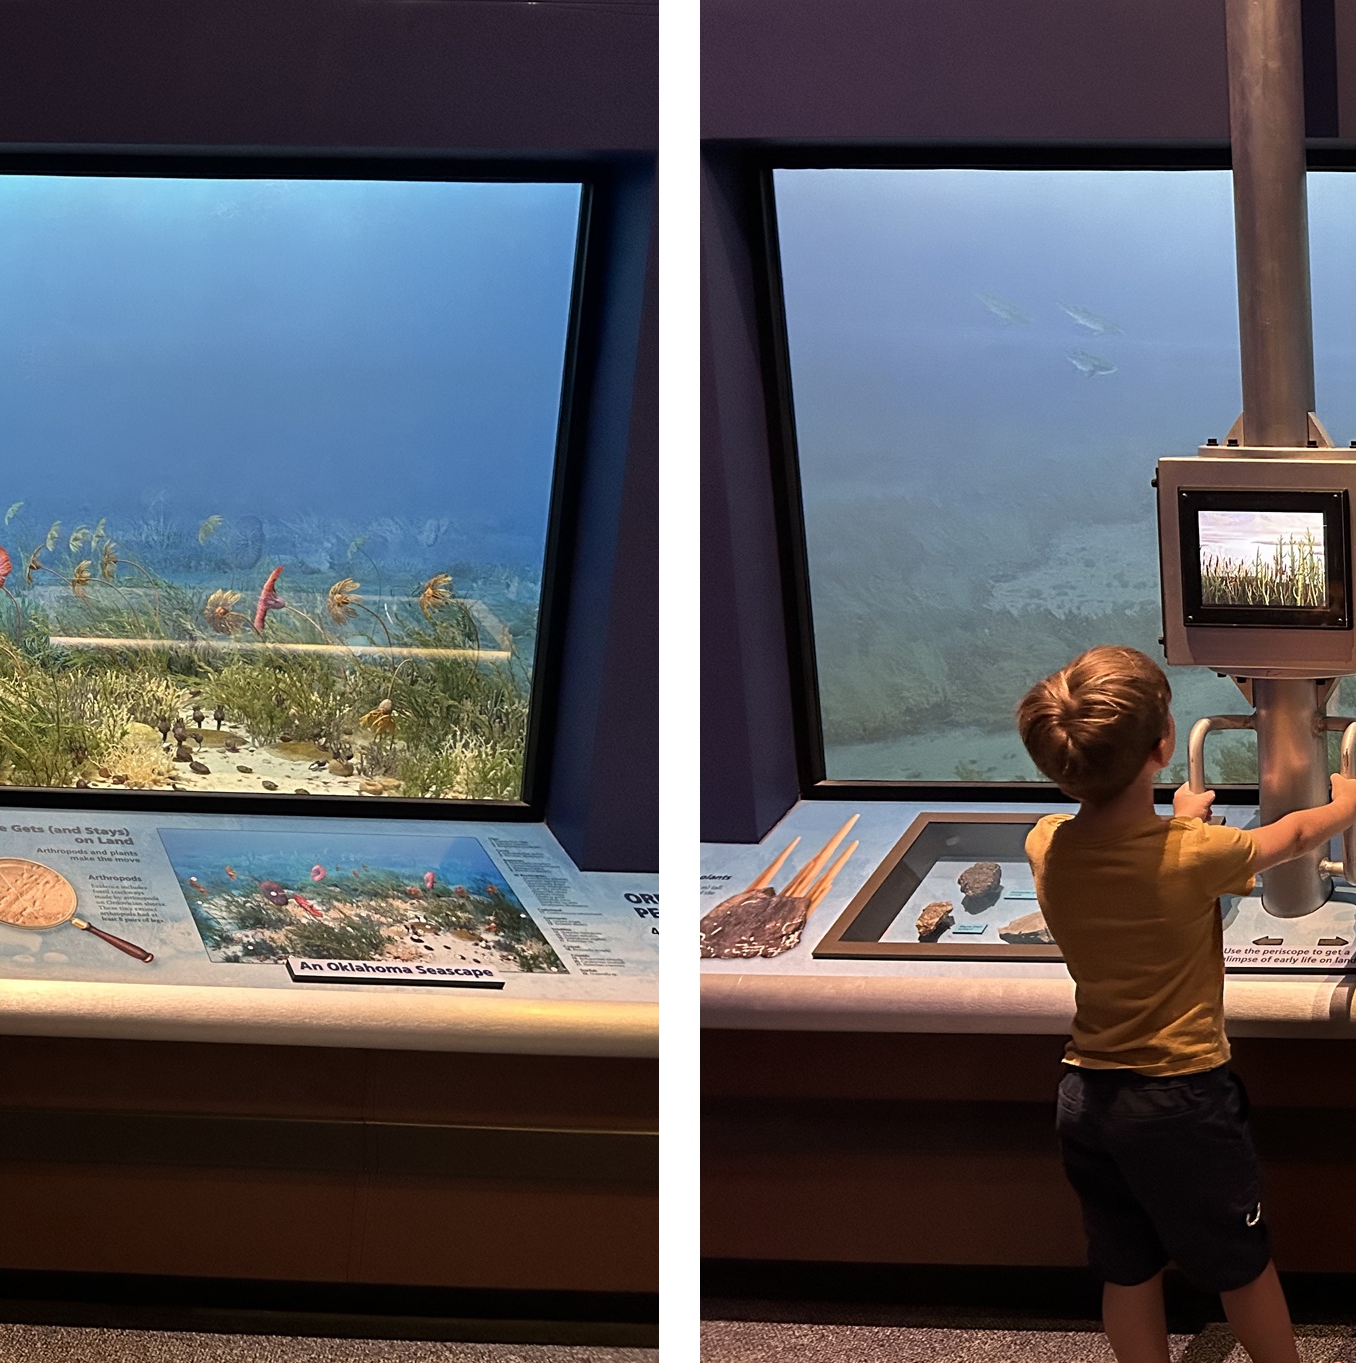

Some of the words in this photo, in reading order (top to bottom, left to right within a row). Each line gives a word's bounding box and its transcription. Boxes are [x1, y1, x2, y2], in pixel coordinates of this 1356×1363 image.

[11, 825, 43, 833] Gets
[49, 826, 81, 834] (and
[85, 827, 130, 836] Stays)
[98, 837, 134, 845] Land
[624, 893, 659, 904] OR
[300, 961, 323, 971] An
[327, 962, 412, 974] Oklahoma
[416, 966, 493, 978] Seascape
